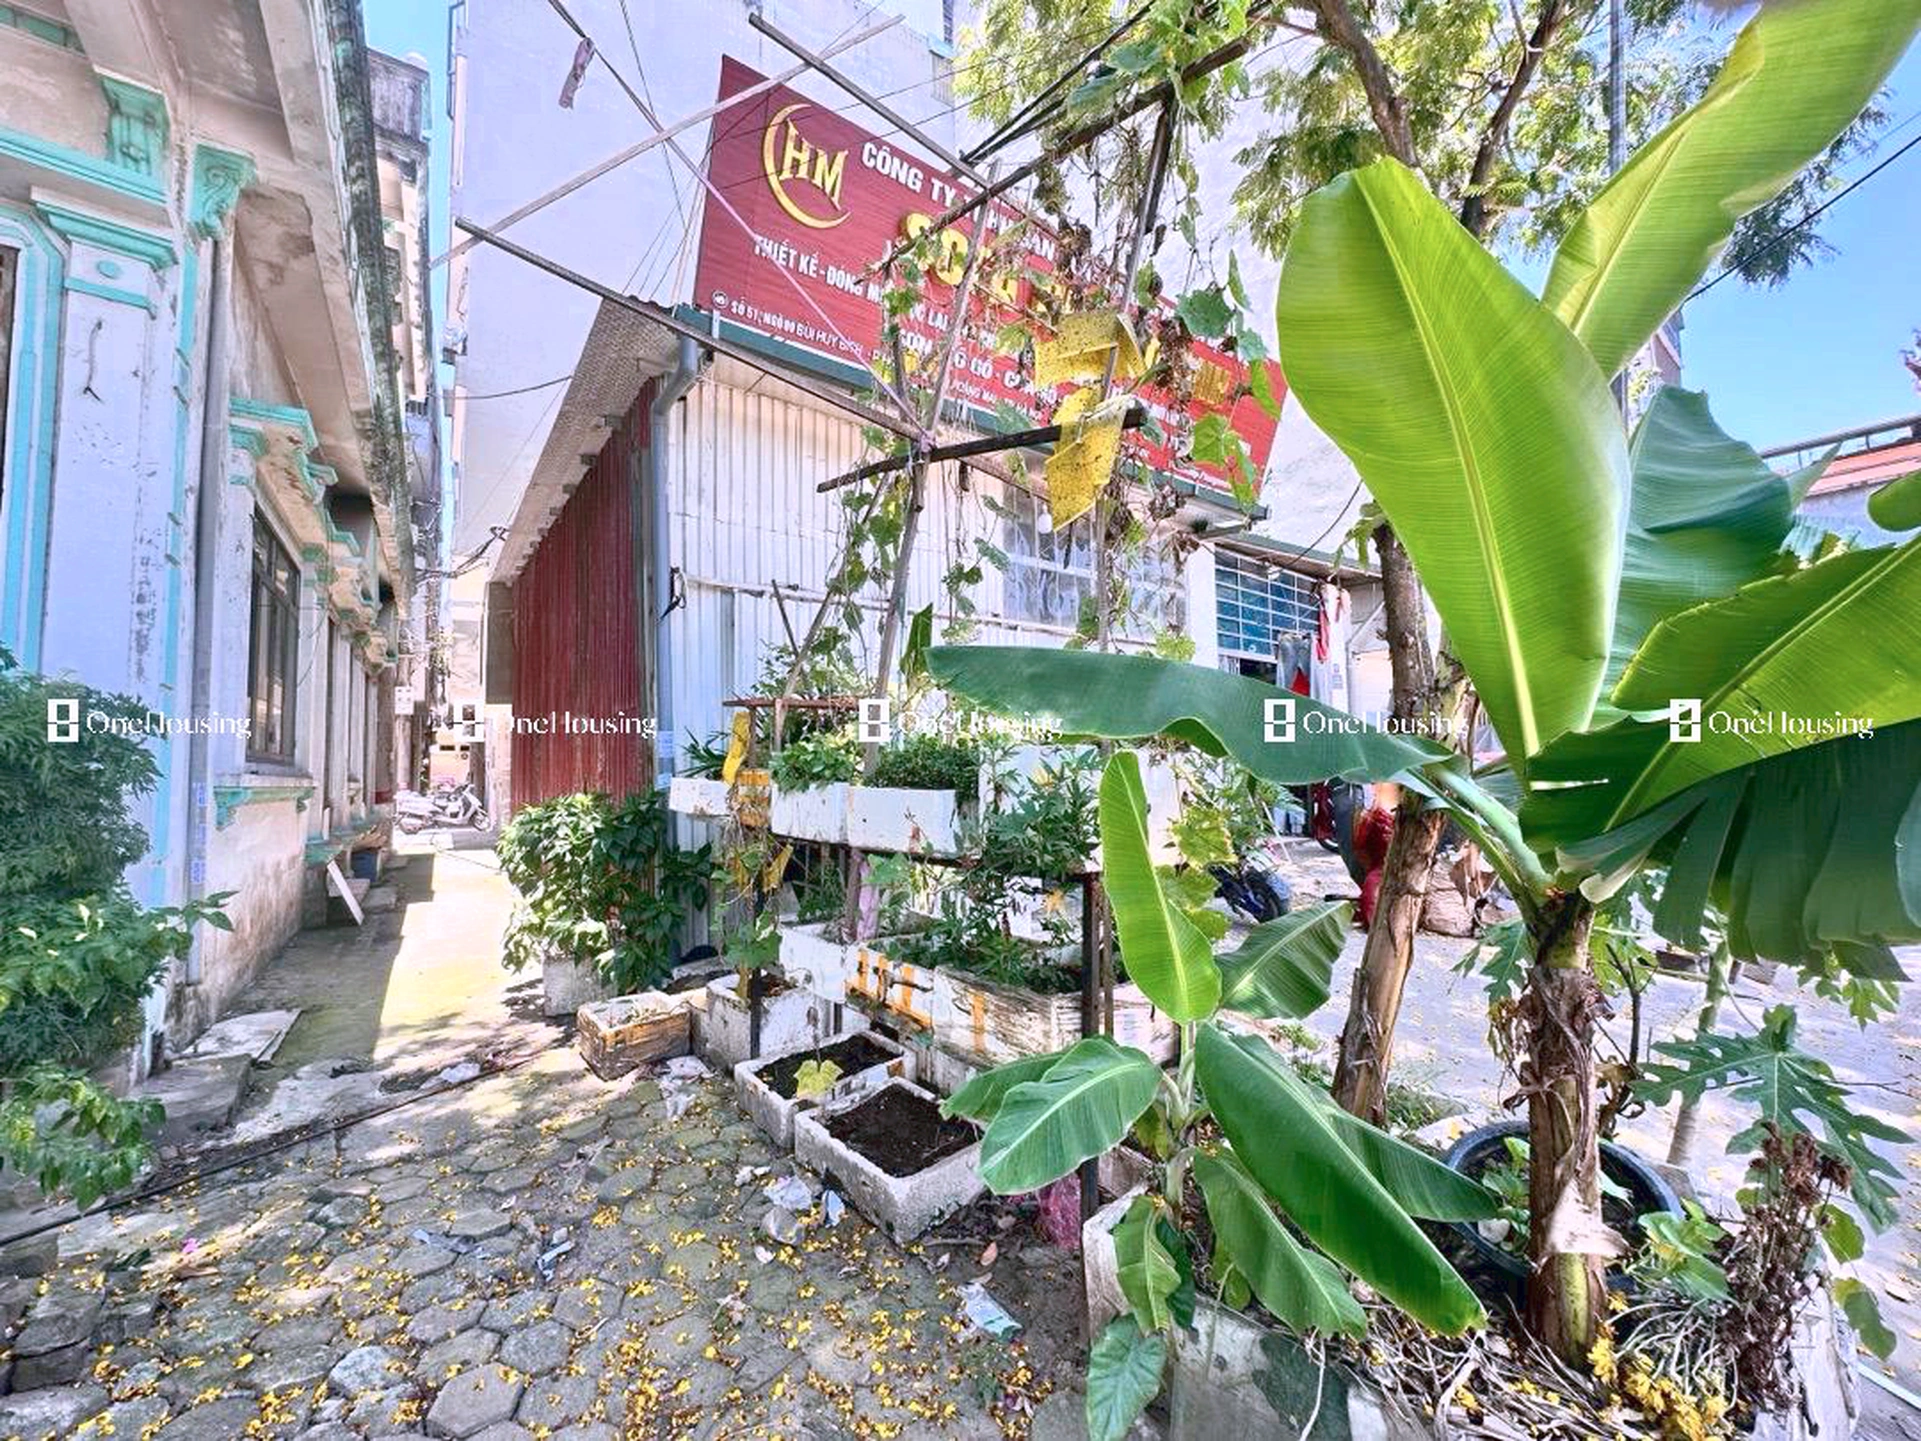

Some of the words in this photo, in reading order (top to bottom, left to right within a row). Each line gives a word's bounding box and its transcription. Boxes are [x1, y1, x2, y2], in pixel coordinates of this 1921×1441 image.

[861, 142, 924, 193] CÔNG
[754, 234, 797, 269] THIẾT
[798, 251, 819, 278] KẾ
